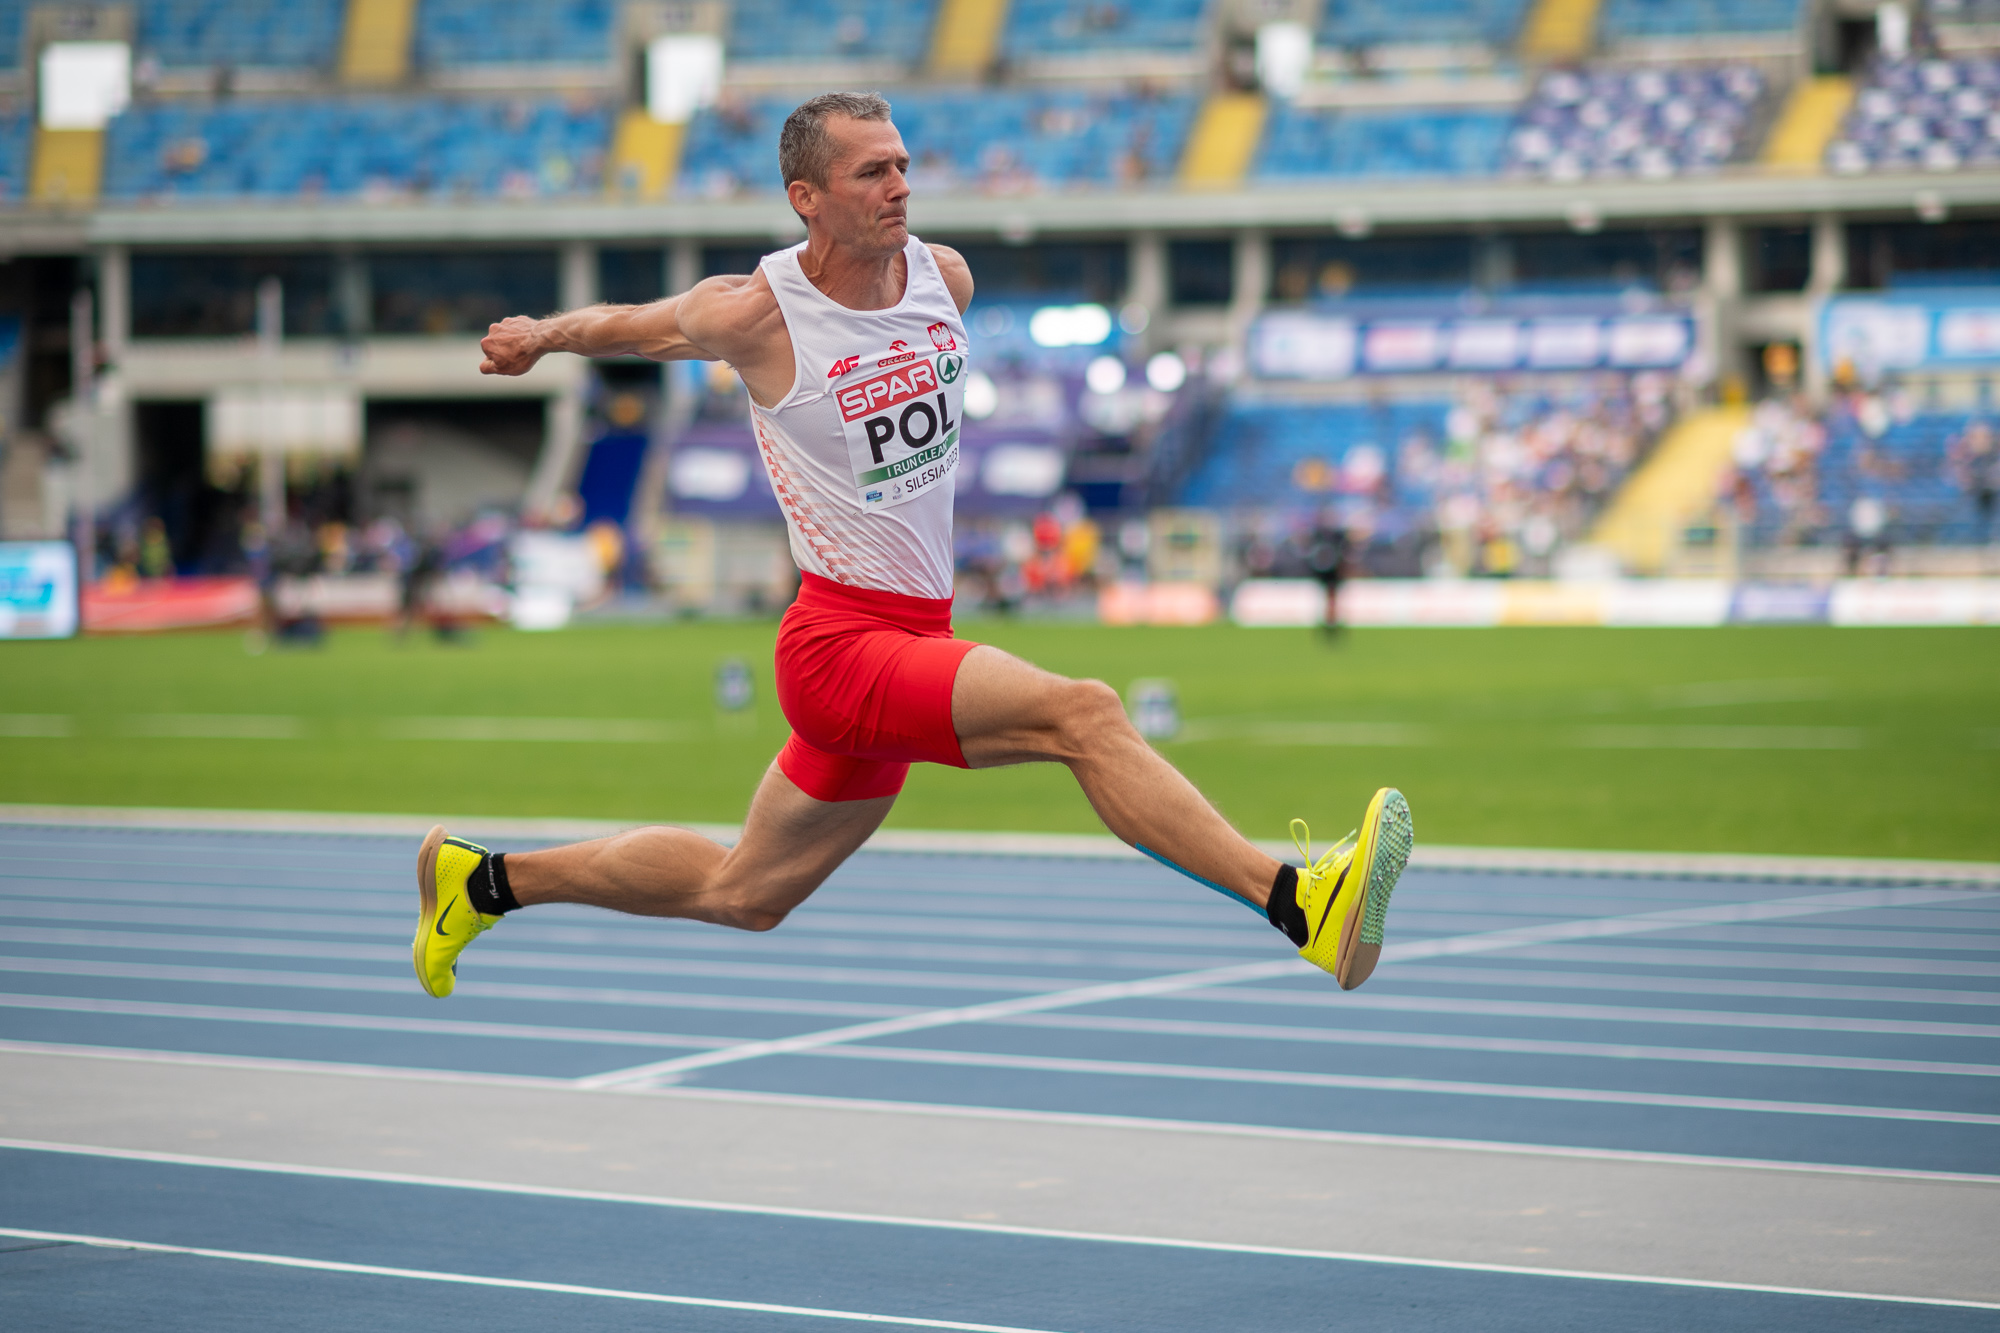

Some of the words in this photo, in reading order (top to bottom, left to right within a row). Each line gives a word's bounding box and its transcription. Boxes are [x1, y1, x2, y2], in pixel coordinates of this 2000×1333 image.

[841, 364, 935, 417] SPAR
[864, 392, 955, 464] POL
[886, 467, 892, 478] I
[893, 457, 918, 476] RUN
[918, 443, 948, 464] CLEAN
[905, 464, 946, 493] SILESIA
